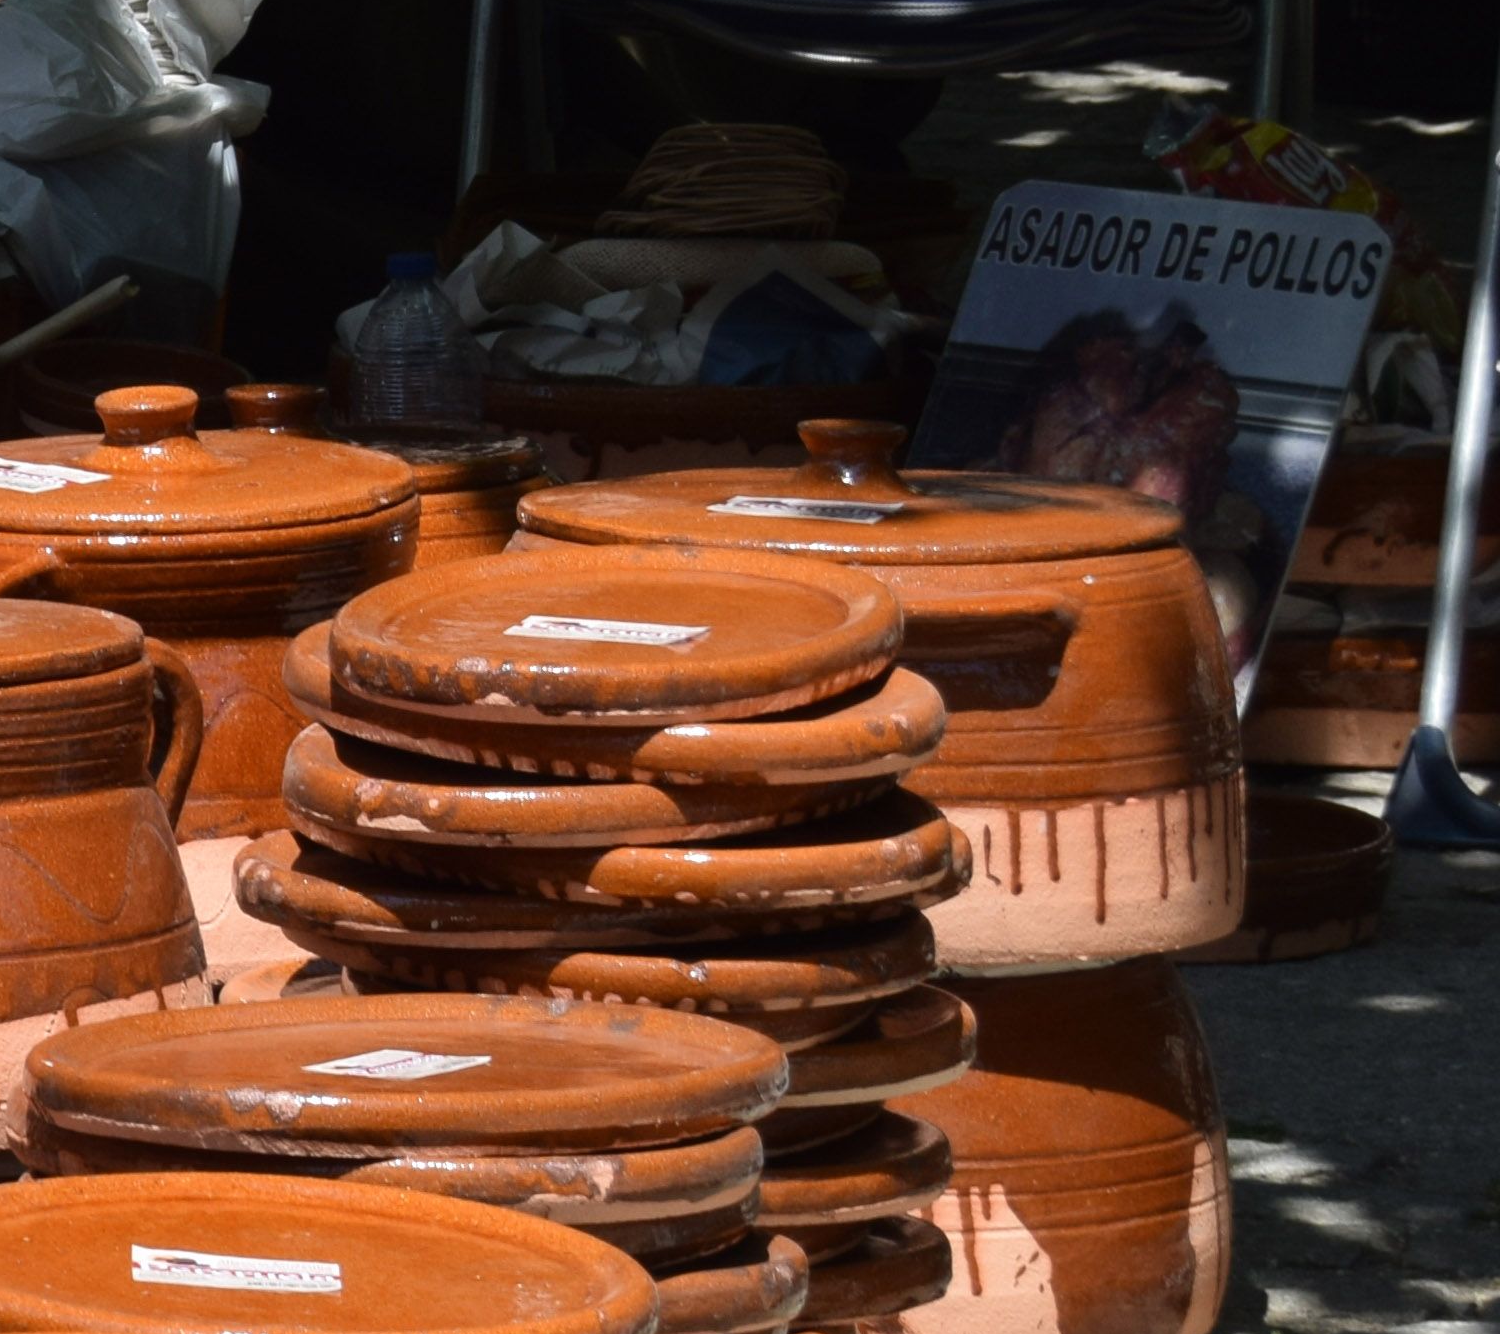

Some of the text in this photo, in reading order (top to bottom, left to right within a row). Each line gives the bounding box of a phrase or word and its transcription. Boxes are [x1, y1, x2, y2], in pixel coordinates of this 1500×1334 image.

[980, 205, 1383, 300] ASADOR DE POLLOS
